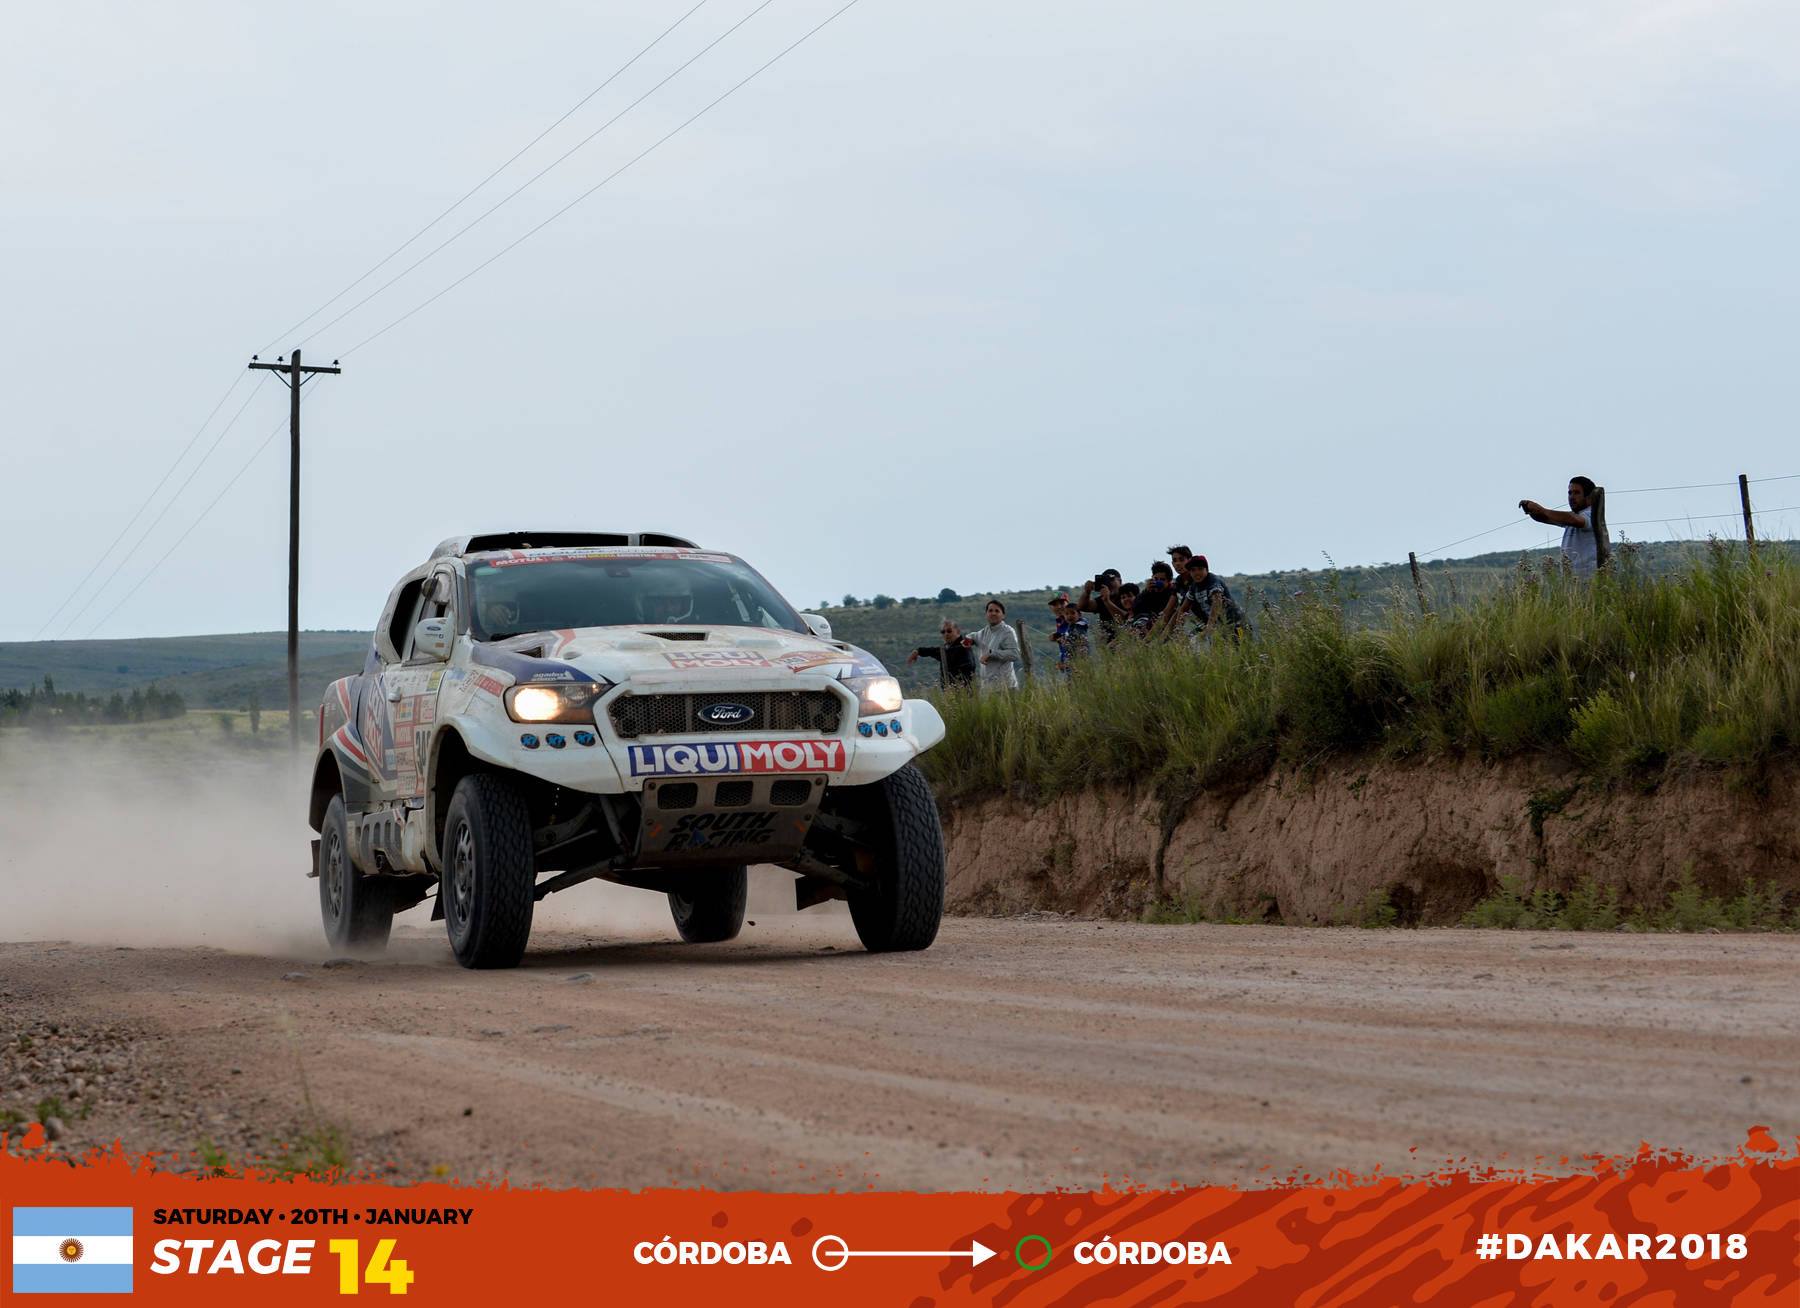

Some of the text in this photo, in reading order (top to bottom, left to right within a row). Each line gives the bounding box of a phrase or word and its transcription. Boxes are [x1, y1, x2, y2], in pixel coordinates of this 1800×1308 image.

[673, 658, 766, 669] MOLY
[711, 705, 742, 720] Ford
[633, 741, 841, 774] LIQUI MOLY
[669, 811, 781, 834] SOUTH
[663, 828, 777, 851] RACING
